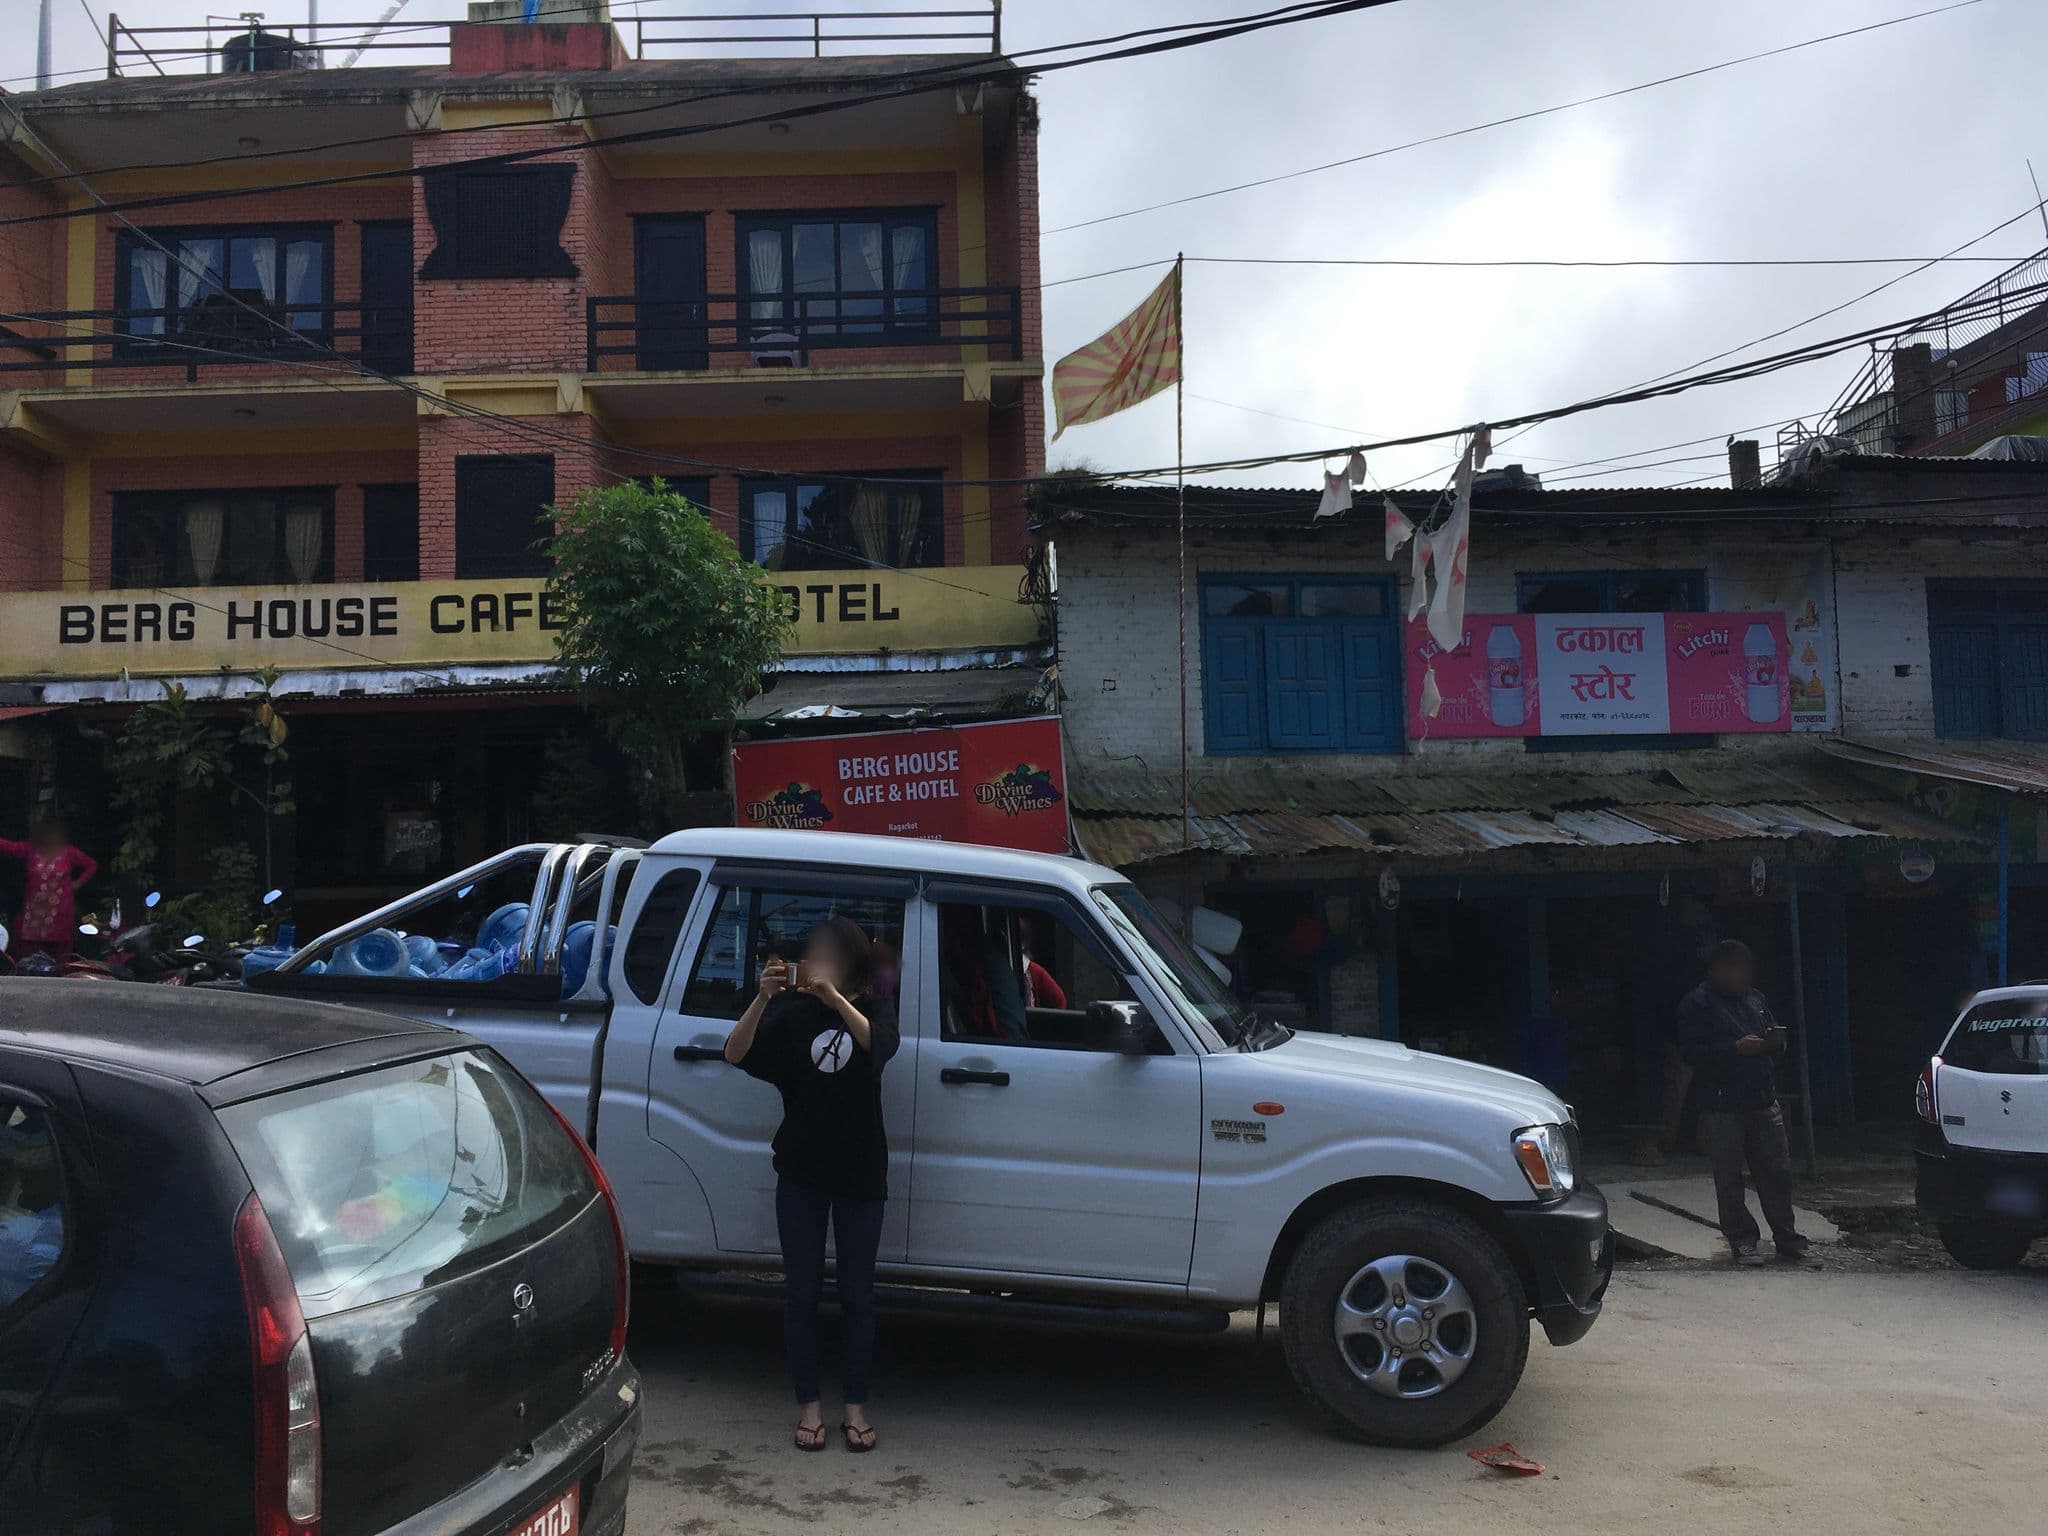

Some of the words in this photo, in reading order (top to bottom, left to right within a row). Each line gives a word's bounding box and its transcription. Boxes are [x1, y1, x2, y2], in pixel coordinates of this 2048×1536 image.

[60, 603, 195, 643] BERG
[228, 597, 396, 640] HOUSE
[428, 591, 567, 634] CAFE
[756, 584, 899, 622] OTEL
[1555, 627, 1645, 653] ढकाल
[1678, 629, 1728, 657] Litchi
[1570, 665, 1635, 701] स्टोर
[838, 756, 889, 780] BERG
[895, 750, 959, 776] HOUSE
[844, 784, 885, 805] CAFE
[889, 783, 901, 801] &
[905, 779, 959, 800] HOTEL
[975, 783, 1033, 804] Divine
[996, 796, 1052, 814] Wines
[746, 801, 804, 821] Divine
[768, 815, 825, 829] Wines
